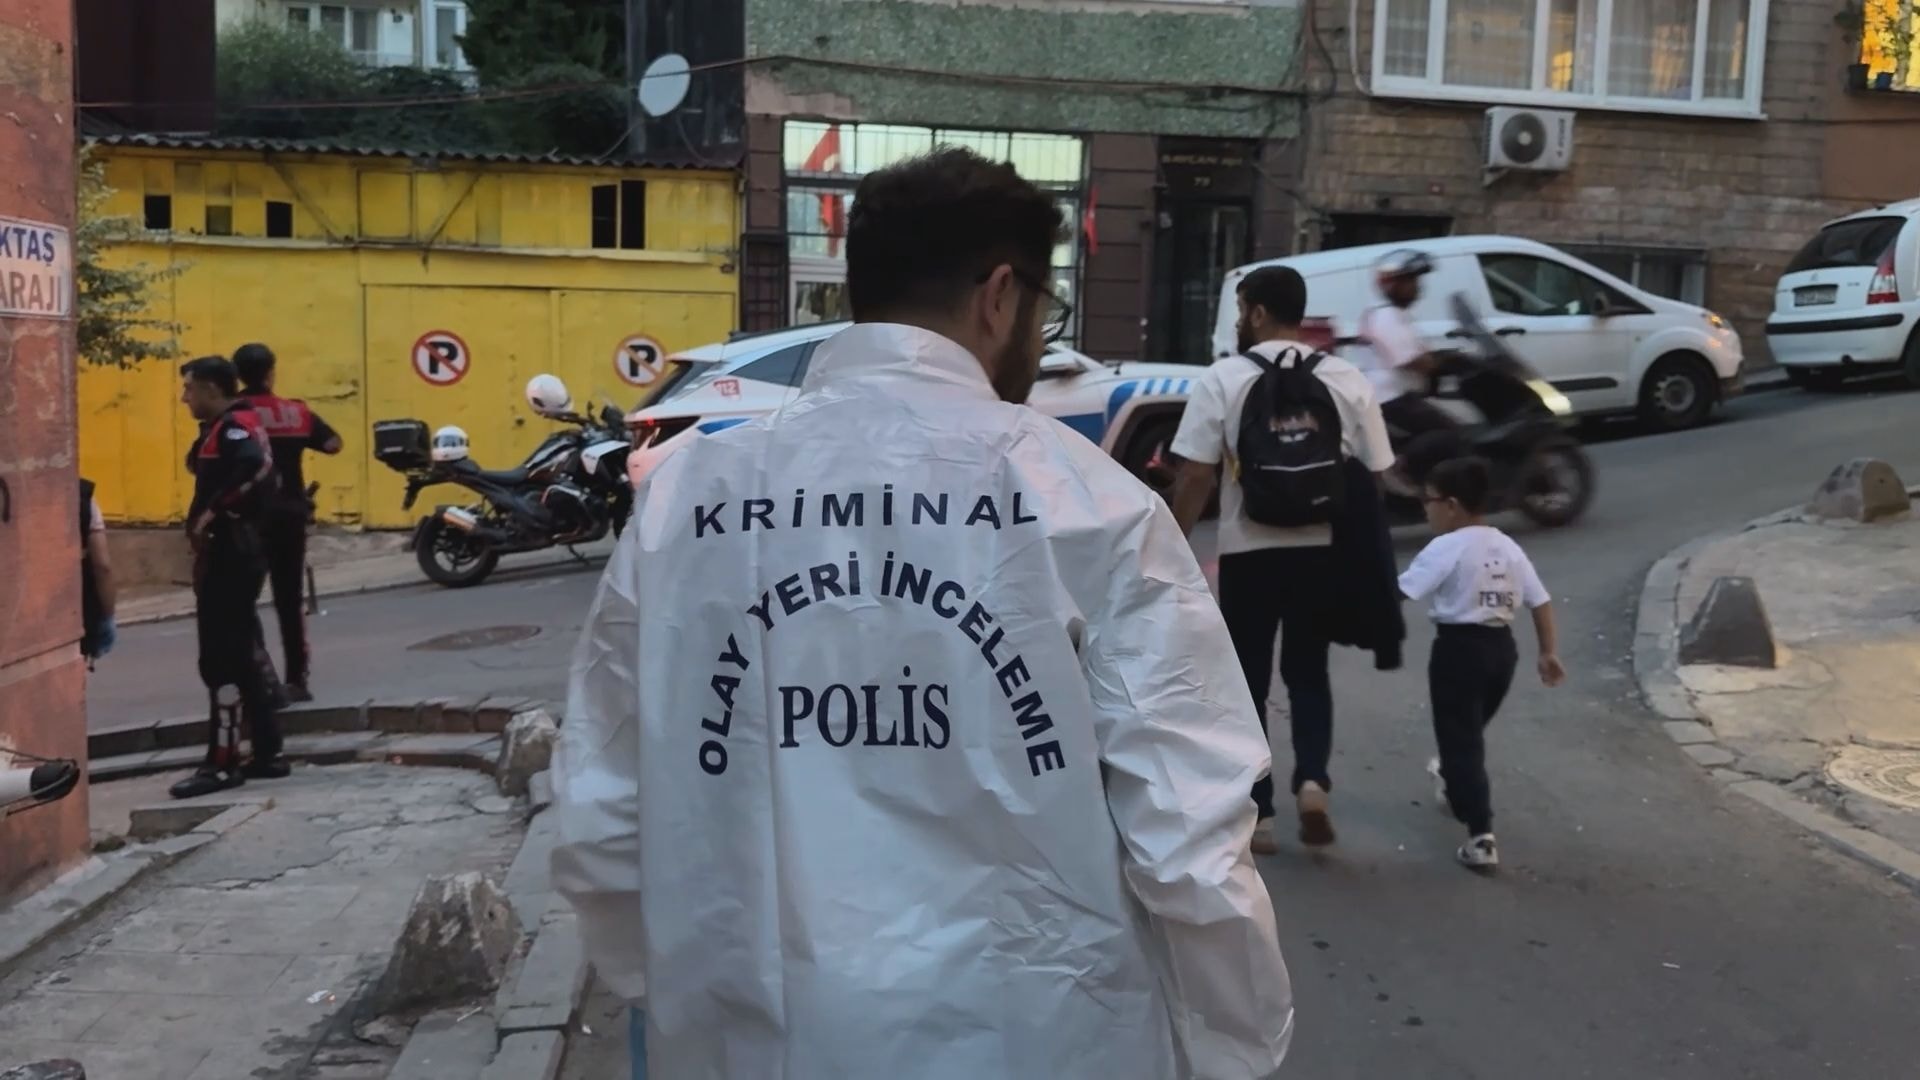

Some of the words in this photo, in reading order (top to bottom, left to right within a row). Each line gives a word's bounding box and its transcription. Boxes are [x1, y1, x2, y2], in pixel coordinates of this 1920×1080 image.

[694, 484, 1038, 538] KRİMİNAL
[699, 633, 751, 776] OLAY
[746, 550, 862, 632] YERİ
[879, 550, 1066, 777] İNCELEME
[777, 664, 951, 750] POLİS
